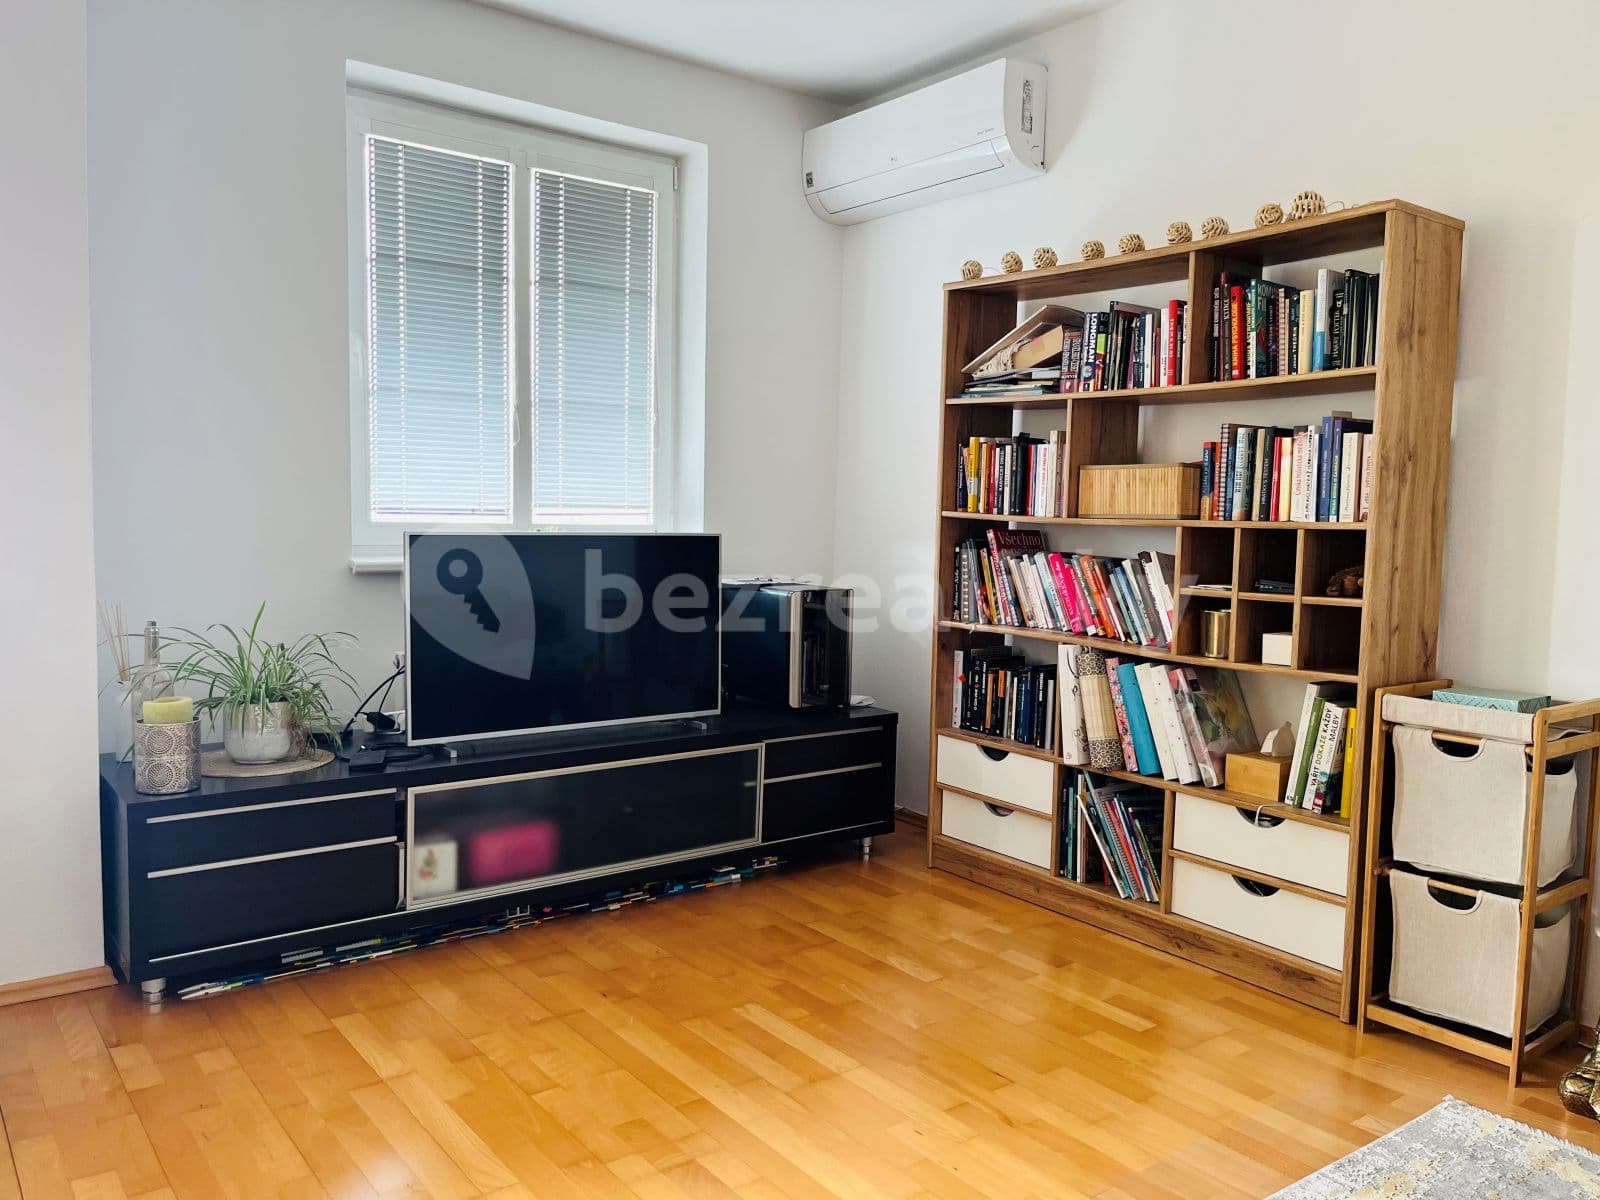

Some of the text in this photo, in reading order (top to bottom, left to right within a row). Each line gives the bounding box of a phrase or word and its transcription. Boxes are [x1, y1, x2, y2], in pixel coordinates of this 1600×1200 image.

[1088, 313, 1098, 363] LONGMAN
[998, 531, 1041, 546] Všechno
[1321, 707, 1333, 734] KAŽDÝ
[1328, 714, 1340, 742] MALBY
